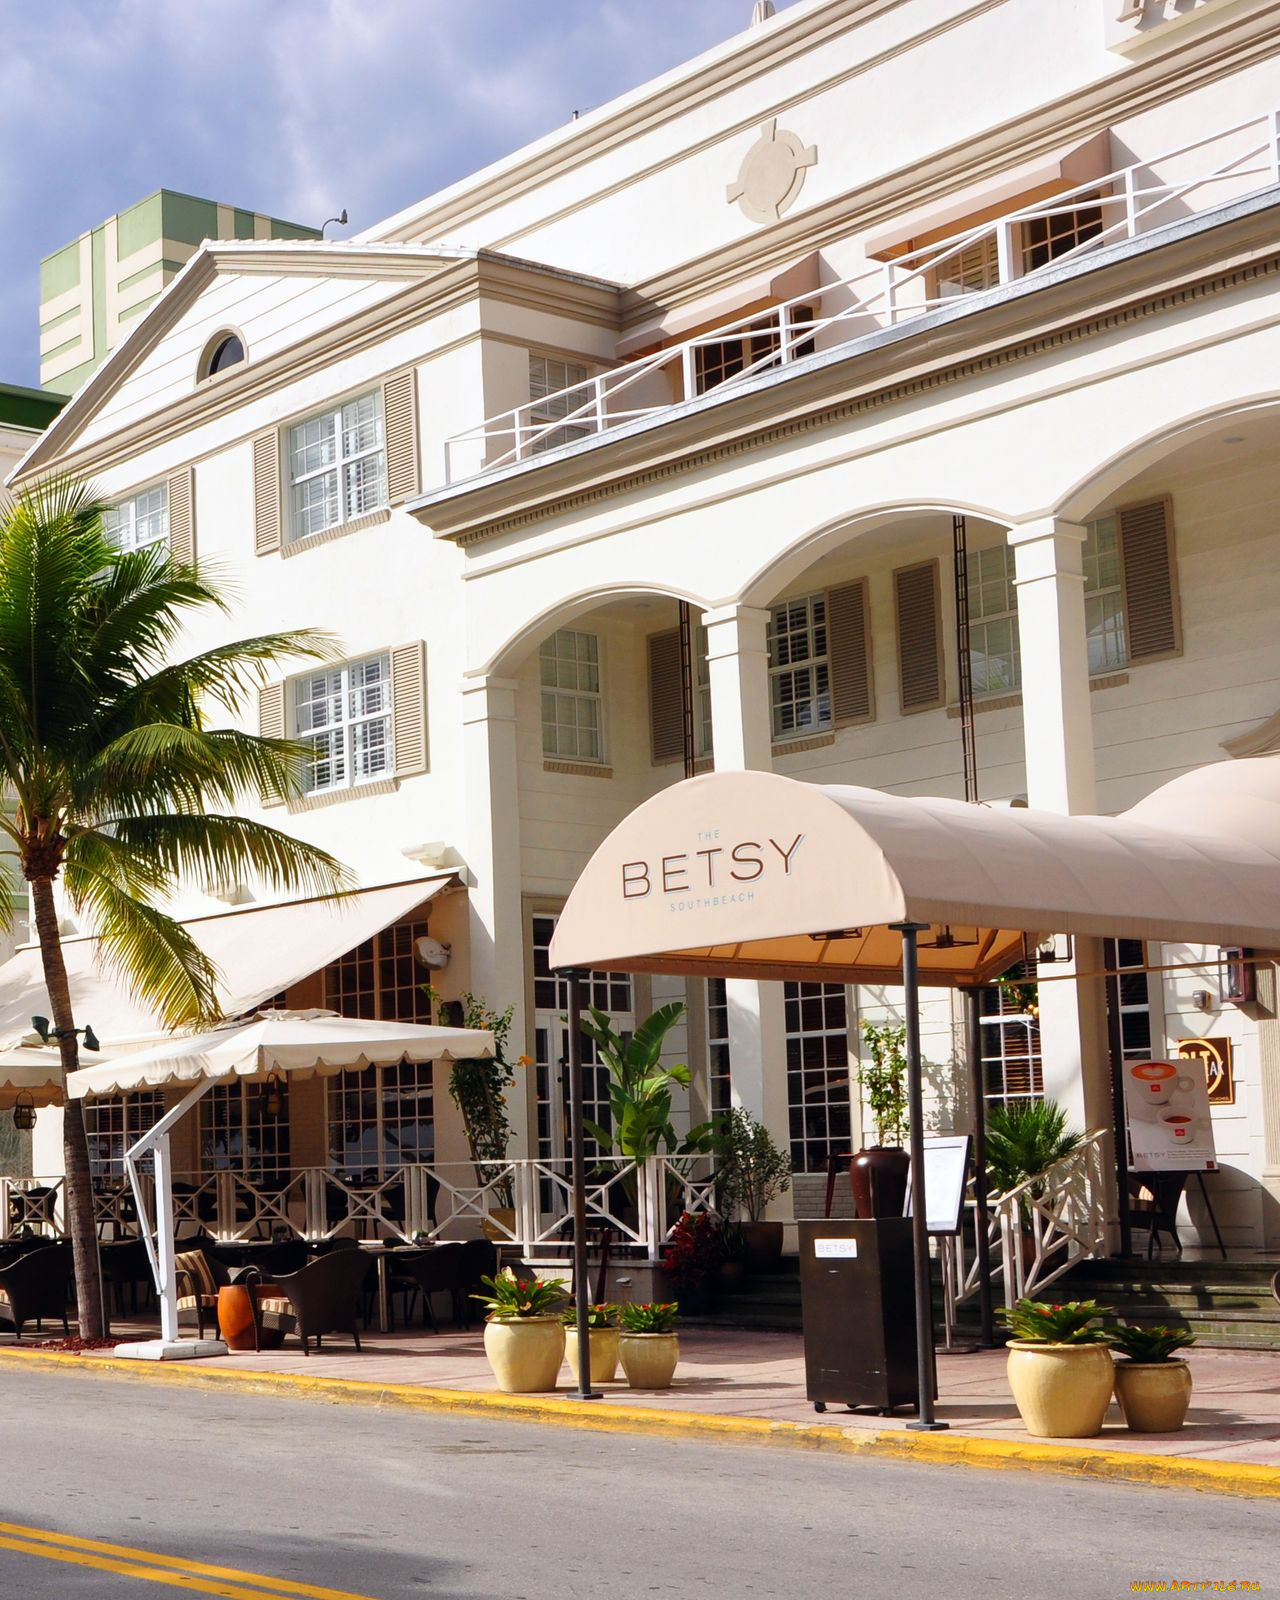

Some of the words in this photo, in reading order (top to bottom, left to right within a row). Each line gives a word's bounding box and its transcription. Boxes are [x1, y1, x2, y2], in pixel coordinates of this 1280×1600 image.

[698, 829, 720, 841] THE
[622, 833, 805, 900] BETSY
[817, 1243, 853, 1253] BETSY
